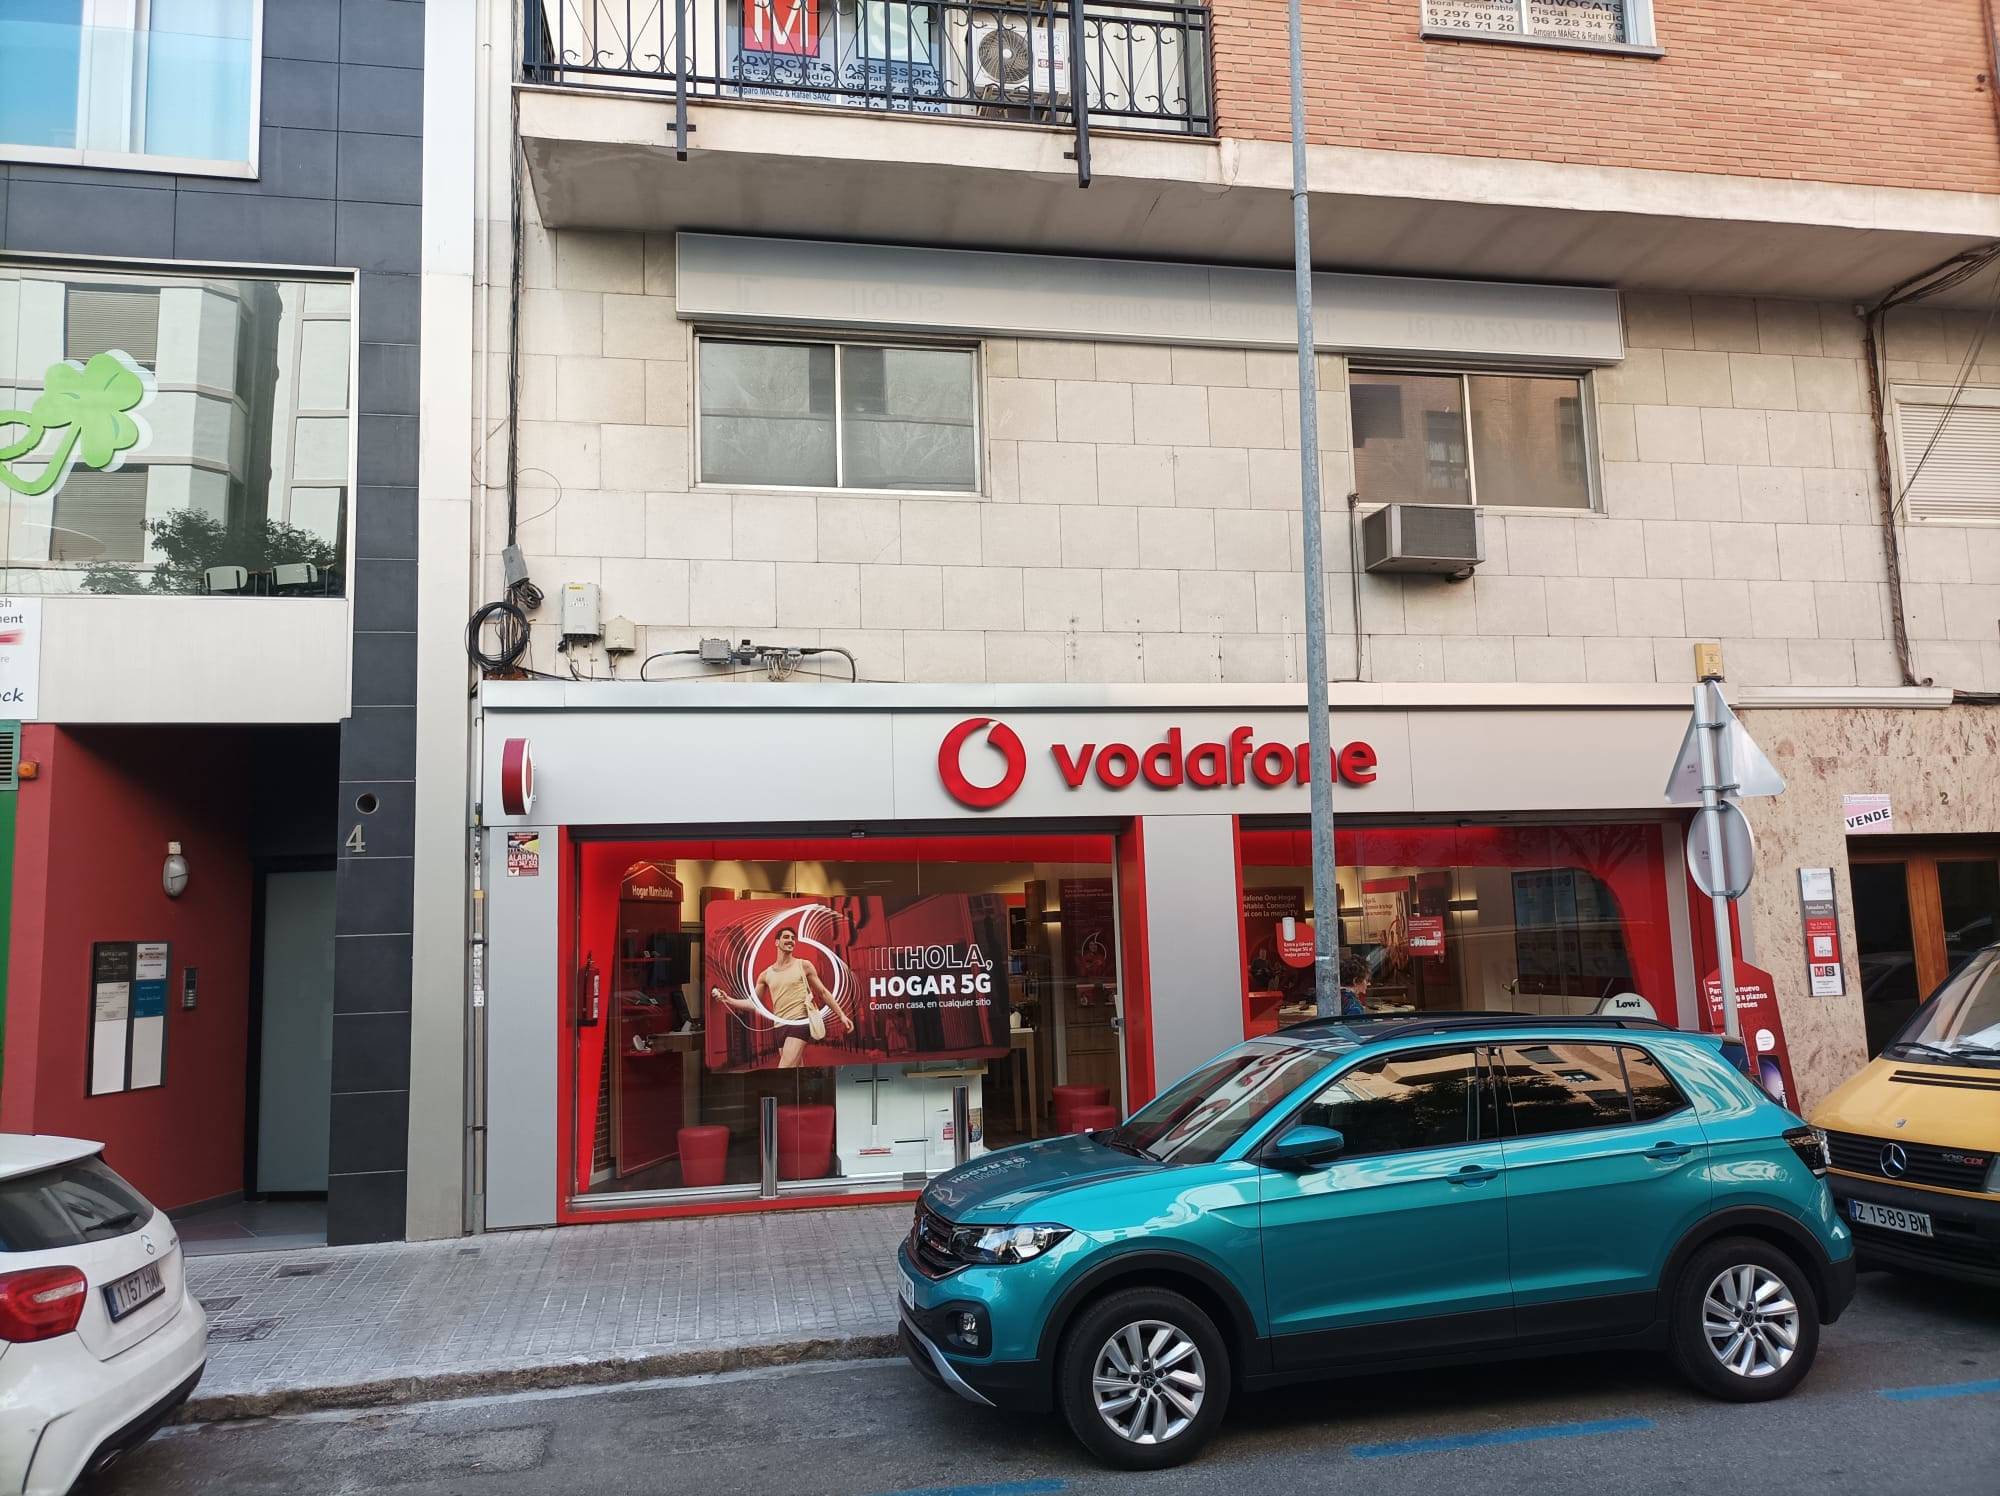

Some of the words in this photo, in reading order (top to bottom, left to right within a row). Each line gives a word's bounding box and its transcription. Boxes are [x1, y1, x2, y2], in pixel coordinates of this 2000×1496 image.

[1463, 1, 1514, 11] Comptable
[1427, 8, 1438, 16] 6
[1443, 9, 1469, 18] 297
[1474, 12, 1492, 20] 60
[1497, 14, 1513, 22] 42
[1530, 7, 1568, 17] Fiscal
[1580, 11, 1623, 21] Juridic
[754, 0, 809, 47] M
[871, 0, 915, 58] S
[1427, 17, 1448, 26] 33
[1453, 20, 1470, 28] 26
[1475, 21, 1491, 30] 71
[1497, 23, 1515, 31] 20
[1532, 16, 1549, 24] 96
[1555, 18, 1580, 27] 228
[1585, 20, 1601, 28] 34
[1051, 725, 1378, 788] vodafone
[1940, 792, 1949, 805] 2
[1846, 808, 1890, 828] VENDE
[345, 824, 367, 853] 4
[905, 943, 993, 971] HOLA,
[1815, 966, 1824, 977] M
[1827, 966, 1833, 976] S
[869, 974, 957, 998] HOGAR
[960, 973, 992, 994] 5G
[1740, 985, 1760, 993] nuevo
[869, 1001, 893, 1011] Como
[906, 1001, 926, 1010] casa,
[927, 1000, 937, 1008] en
[938, 998, 974, 1009] cualquier
[975, 998, 992, 1007] sitio
[1615, 998, 1641, 1008] Lowi
[1746, 993, 1768, 1002] plazos
[1856, 1203, 1866, 1220] Z
[1870, 1206, 1906, 1229] 1589
[1908, 1213, 1928, 1233] BM
[117, 1276, 141, 1309] 1157
